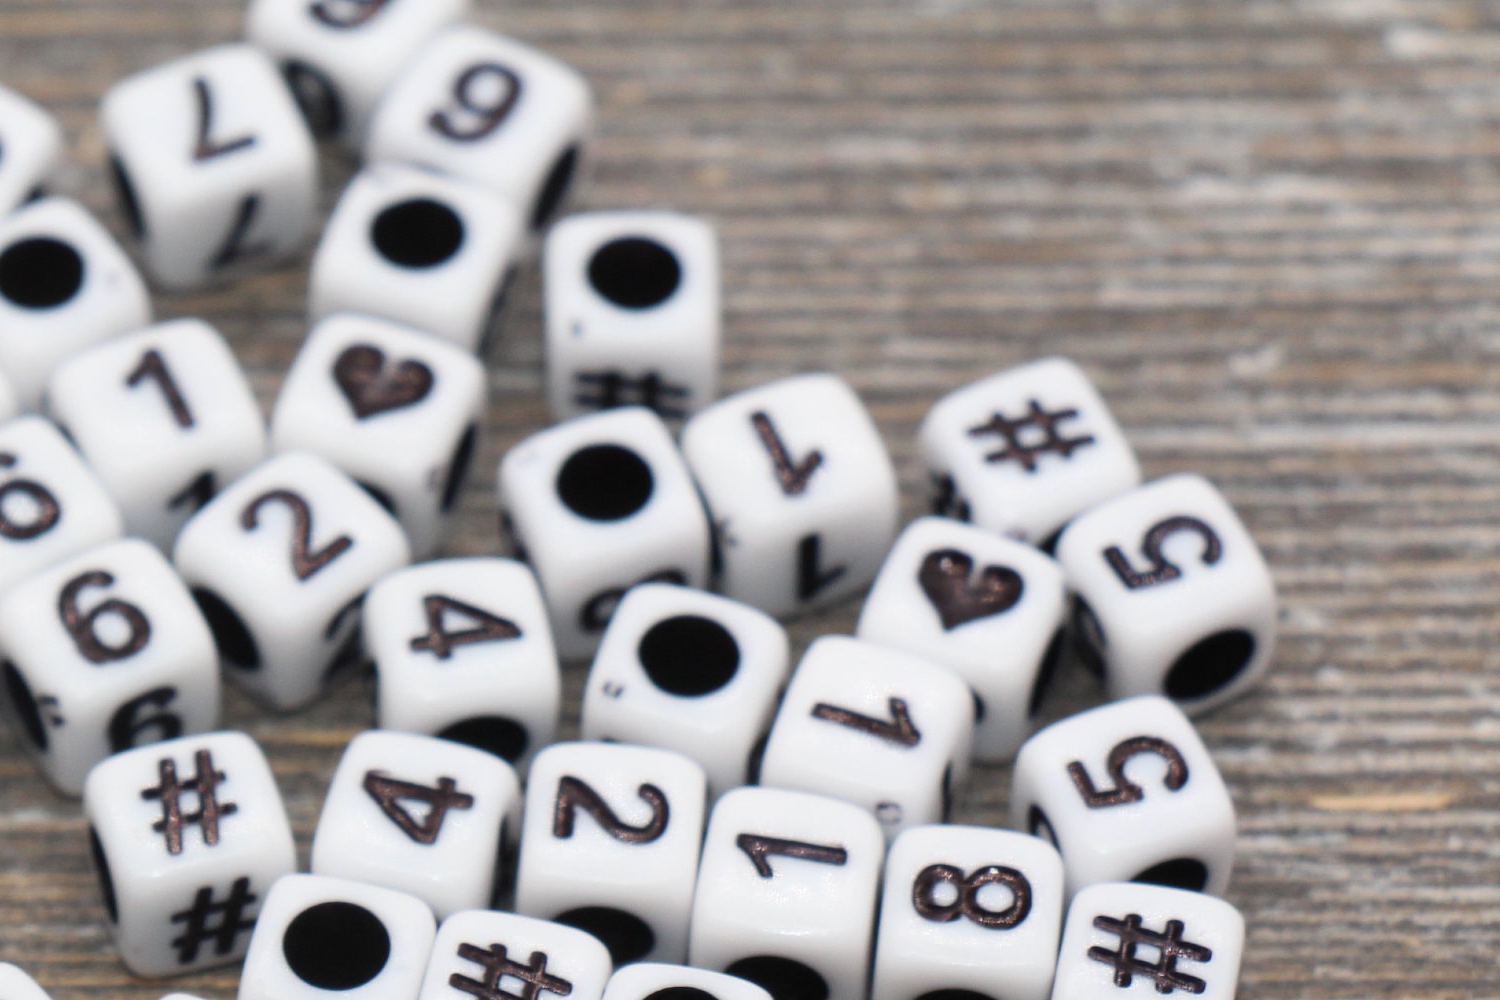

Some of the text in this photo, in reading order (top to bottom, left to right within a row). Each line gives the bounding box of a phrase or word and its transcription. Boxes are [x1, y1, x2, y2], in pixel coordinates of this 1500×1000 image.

[427, 62, 523, 144] 9
[126, 349, 194, 428] 1
[750, 411, 823, 496] 1
[968, 400, 1093, 472] #
[239, 488, 353, 581] 2
[1102, 515, 1222, 590] 5
[57, 570, 151, 664] 6
[409, 594, 522, 660] 4
[811, 697, 921, 748] 1
[141, 750, 237, 855] #
[362, 770, 474, 844] 4
[552, 775, 669, 844] 2
[1067, 735, 1189, 809] 5
[736, 833, 847, 878] 1
[170, 876, 257, 963] #
[912, 864, 1032, 930] 8
[1088, 914, 1212, 994] #
